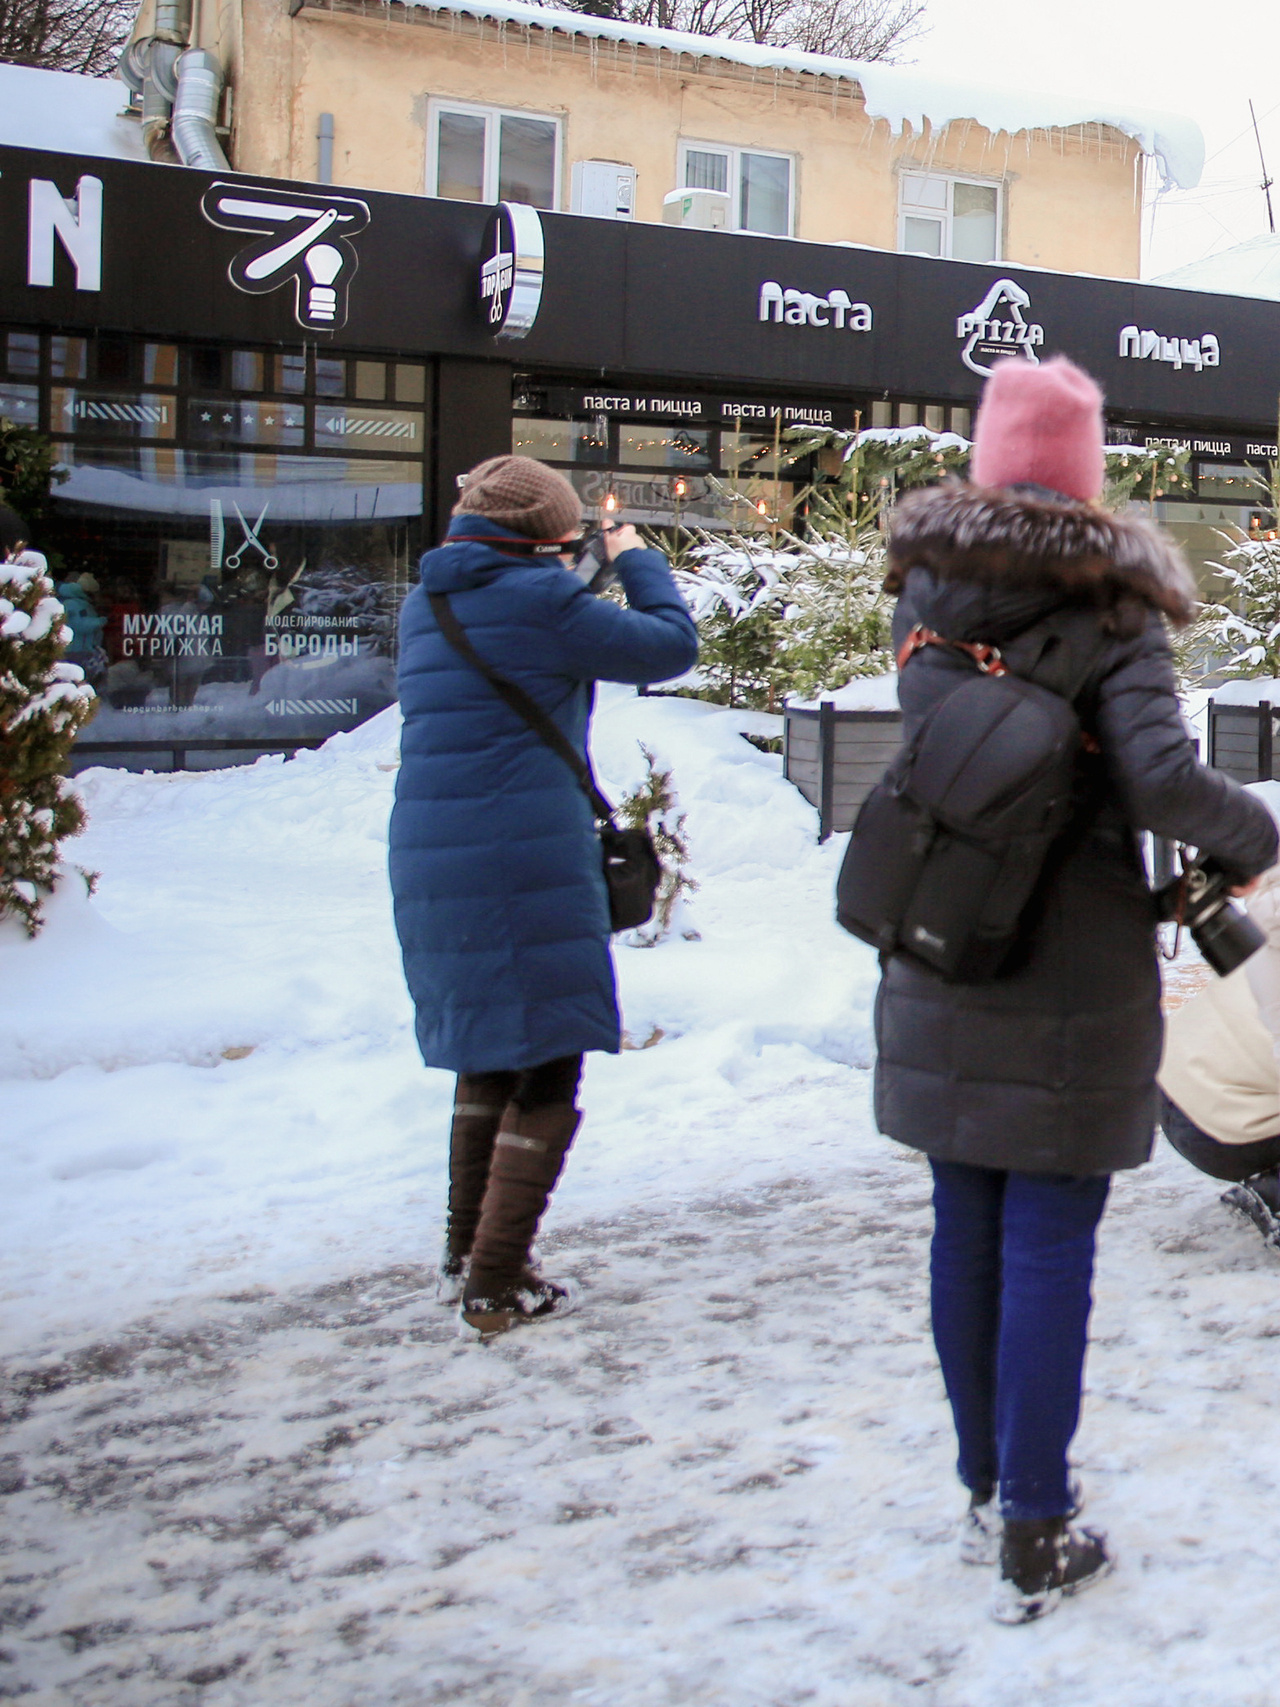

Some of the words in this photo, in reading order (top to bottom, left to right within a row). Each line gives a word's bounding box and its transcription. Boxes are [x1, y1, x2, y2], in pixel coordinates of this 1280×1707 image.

[481, 273, 497, 299] TOP
[500, 265, 513, 291] GUN
[957, 317, 1045, 346] PTIZZA
[583, 395, 630, 411] паста
[636, 397, 646, 412] и
[651, 398, 702, 416] пицца
[722, 402, 766, 418] паста
[770, 405, 782, 418] и
[785, 406, 833, 423] пицца
[1183, 439, 1191, 451] и
[1194, 439, 1231, 455] пицца
[1246, 443, 1278, 457] паста
[123, 614, 223, 635] МУЖСКАЯ
[265, 615, 359, 628] МОДЕЛИРОВАНИЕ
[123, 637, 223, 656] СТРИЖКА
[265, 633, 359, 659] БОРОДЫ
